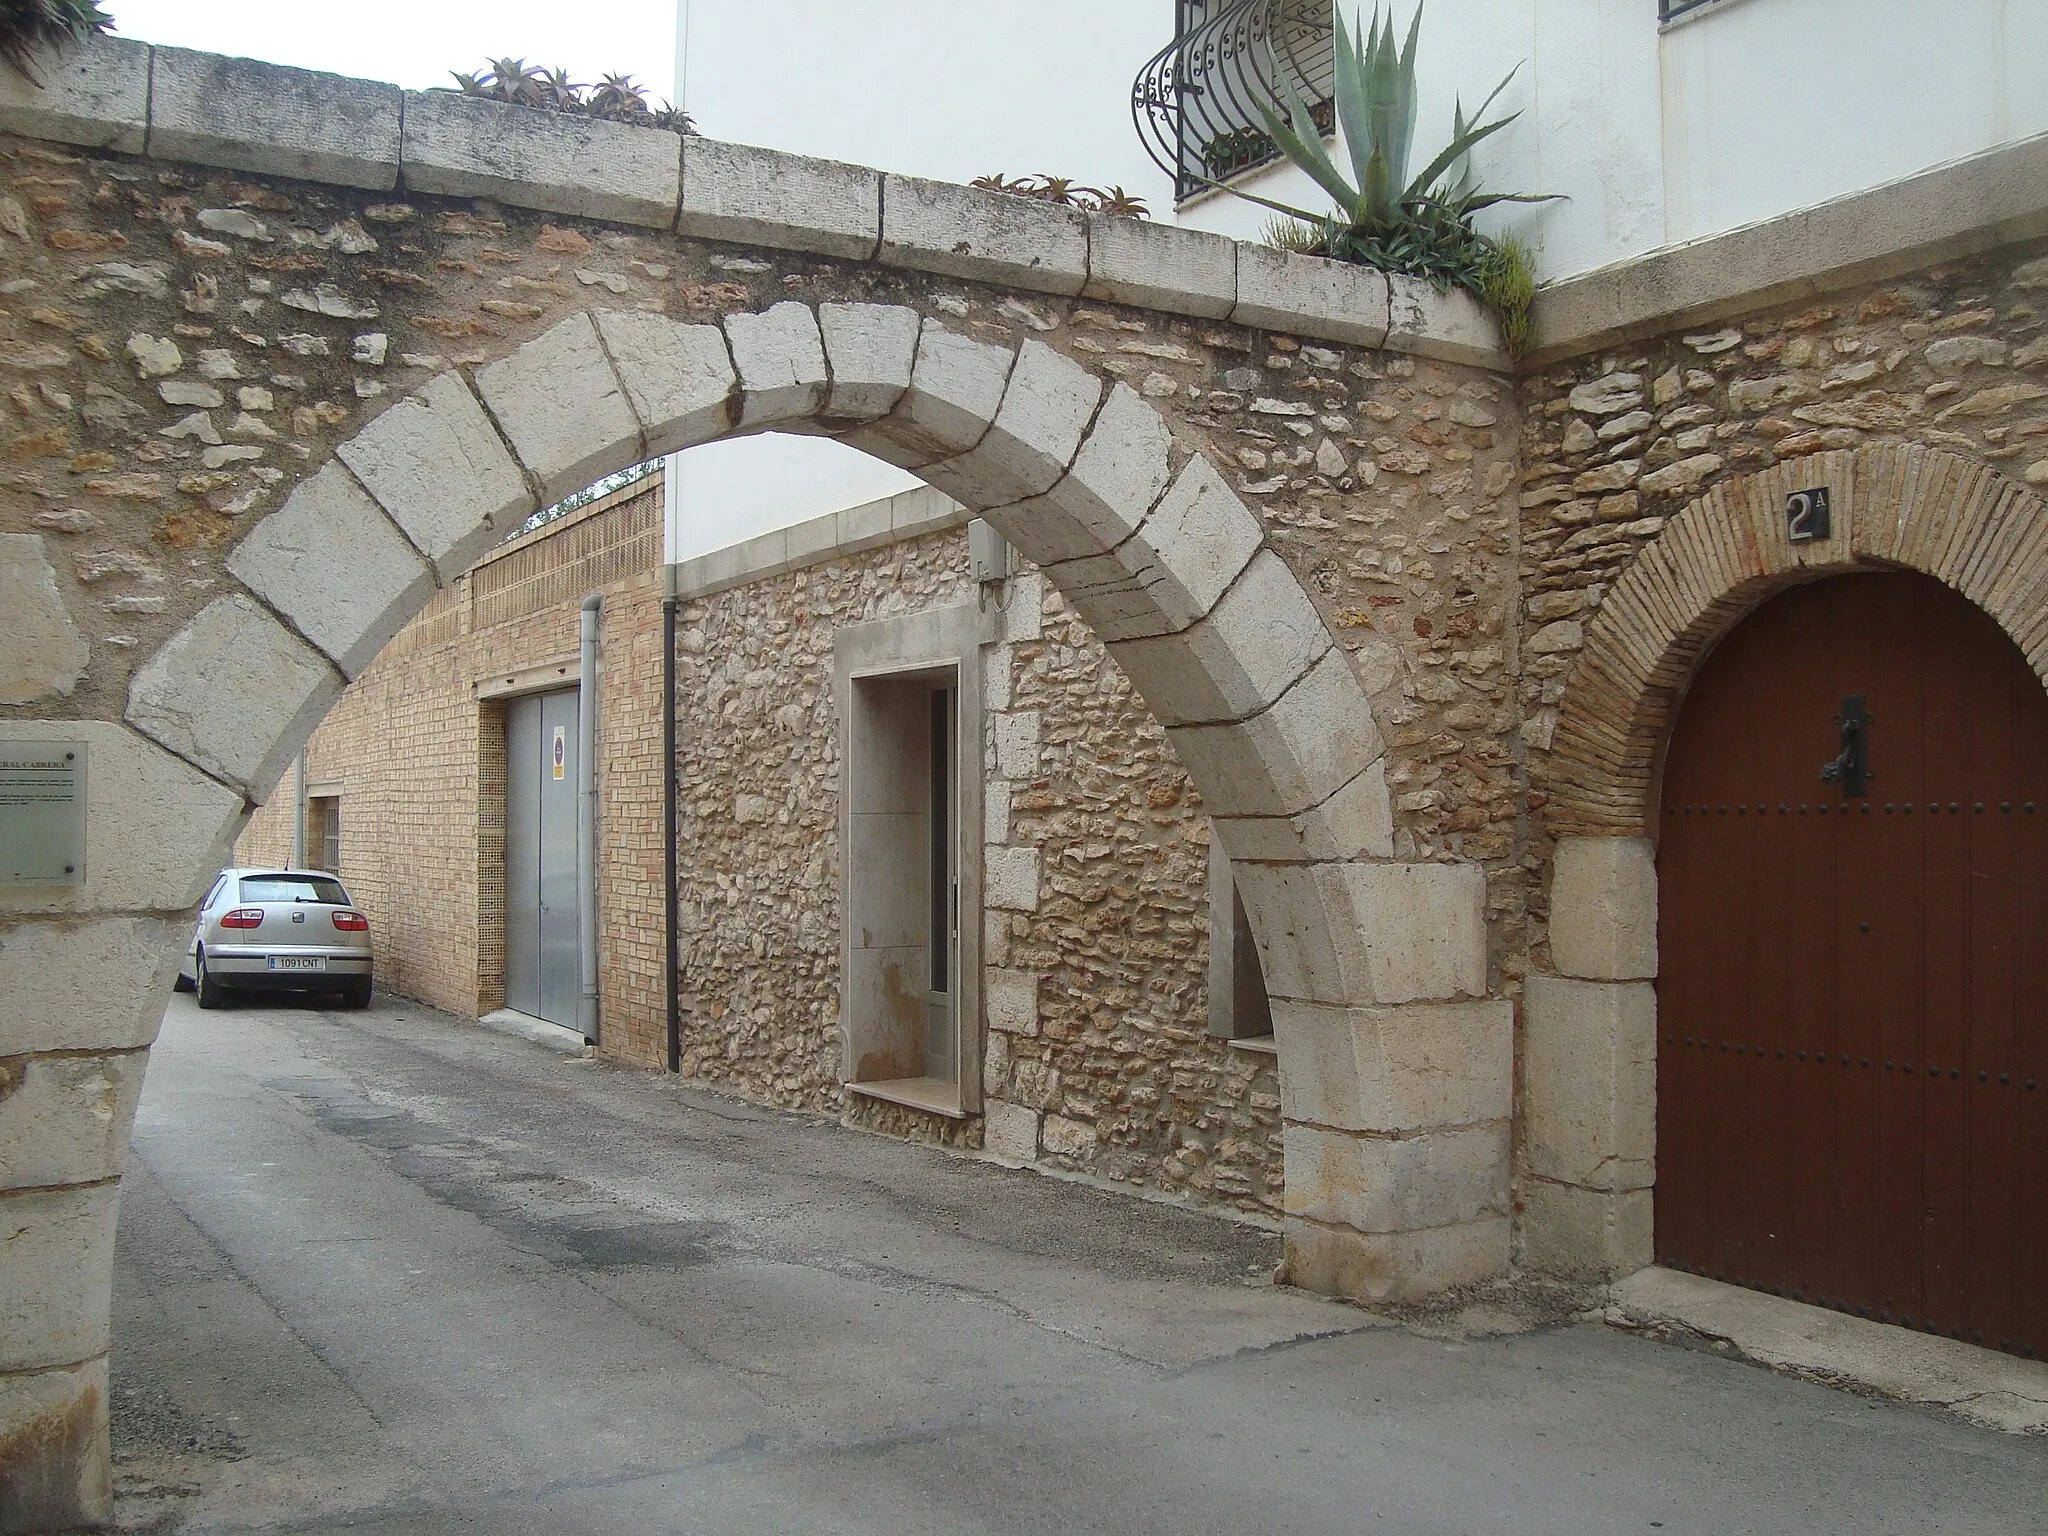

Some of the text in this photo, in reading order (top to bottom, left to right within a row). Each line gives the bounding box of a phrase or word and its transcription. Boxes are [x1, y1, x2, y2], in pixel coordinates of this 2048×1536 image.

[23, 761, 66, 769] CABRERA
[281, 958, 301, 968] 1091
[302, 959, 319, 968] CNT
